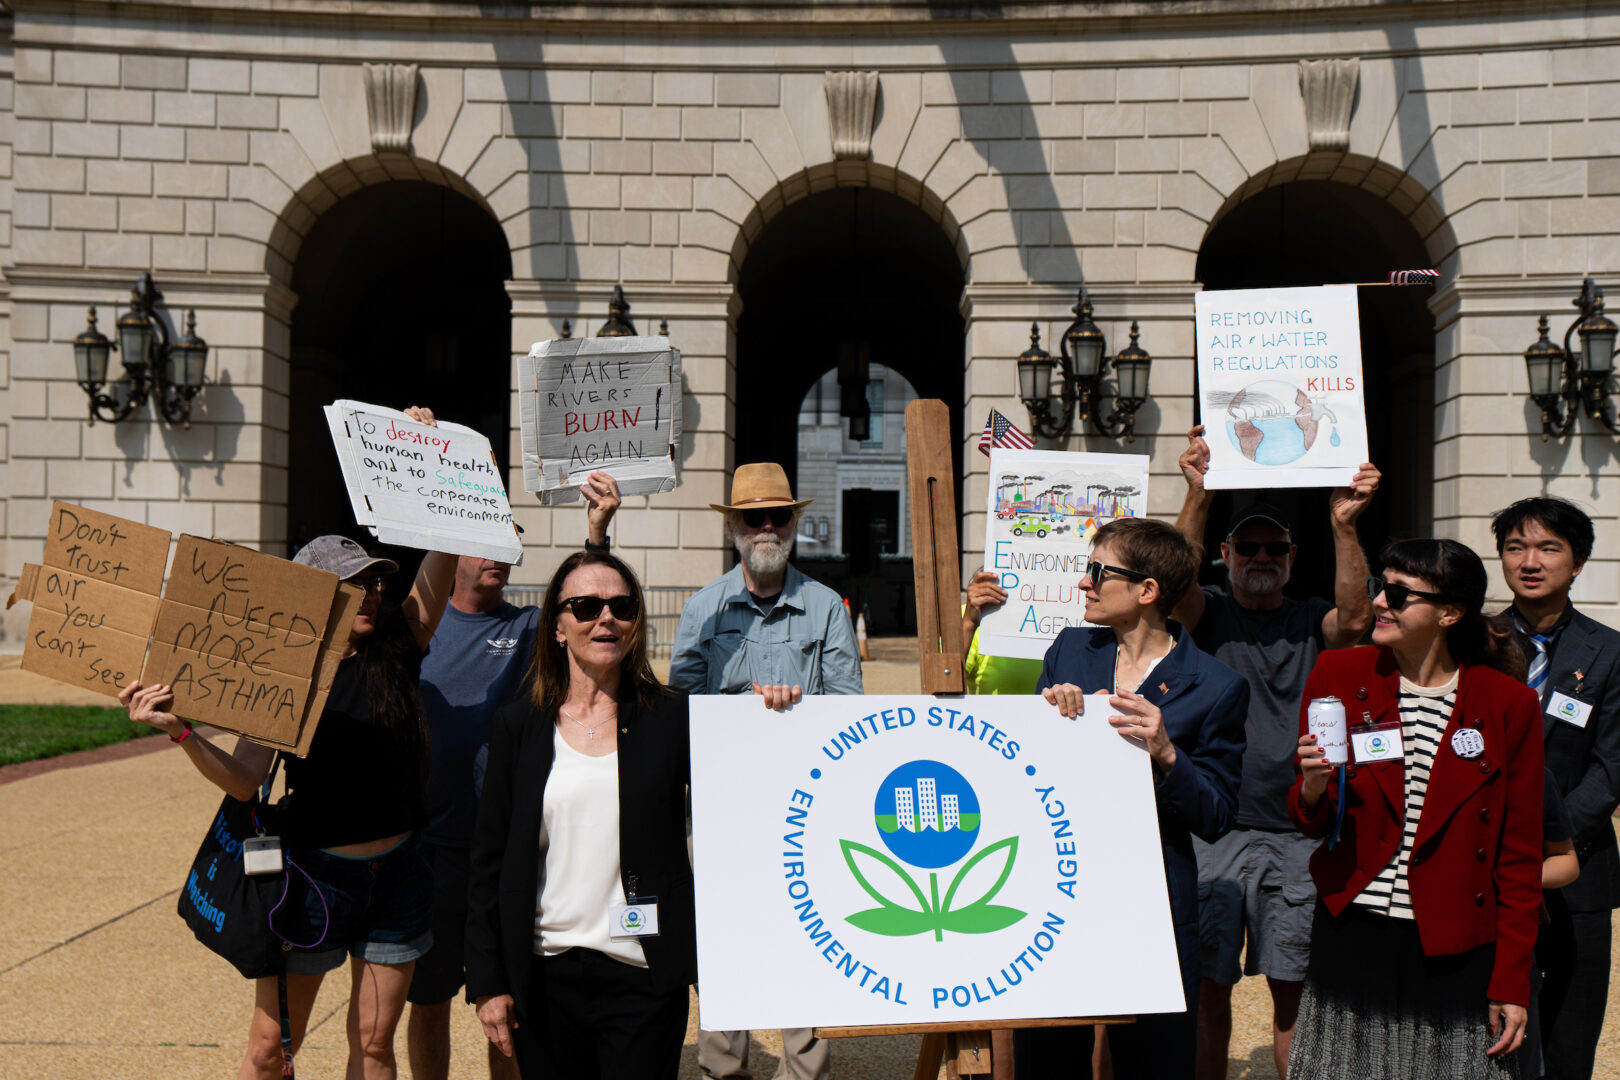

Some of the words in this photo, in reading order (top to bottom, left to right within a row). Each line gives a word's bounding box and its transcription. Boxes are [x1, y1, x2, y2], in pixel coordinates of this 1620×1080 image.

[1211, 310, 1312, 327] REMOVING
[1211, 334, 1242, 349] AIR
[1262, 332, 1328, 348] WATER
[560, 361, 630, 385] MAKE
[1213, 355, 1338, 371] REGULATIONS
[548, 389, 632, 408] RIVERS
[1307, 377, 1355, 391] KILLS
[386, 420, 451, 453] destroy
[565, 406, 641, 436] BURN
[361, 435, 424, 461] human
[438, 453, 494, 476] health
[364, 457, 397, 472] and
[408, 466, 425, 478] to
[570, 440, 643, 467] AGAIN
[372, 475, 408, 492] the
[417, 487, 499, 509] corporate
[58, 509, 127, 545] Don't
[427, 502, 512, 524] environment
[192, 548, 249, 592] WE
[995, 541, 1090, 572] ENVIRONME
[46, 573, 86, 600] air
[1001, 572, 1080, 604] POLLUT
[207, 592, 318, 648] NEED
[173, 622, 276, 676] MORE
[170, 663, 294, 720] ASTHMA
[822, 706, 916, 762] UNITED
[927, 706, 1020, 760] STATES
[207, 857, 217, 881] is
[187, 868, 226, 933] Watching
[783, 788, 907, 1006] ENVIRONMENTAL
[933, 912, 1065, 1009] POLLUTION
[1034, 785, 1078, 899] AGENCY
